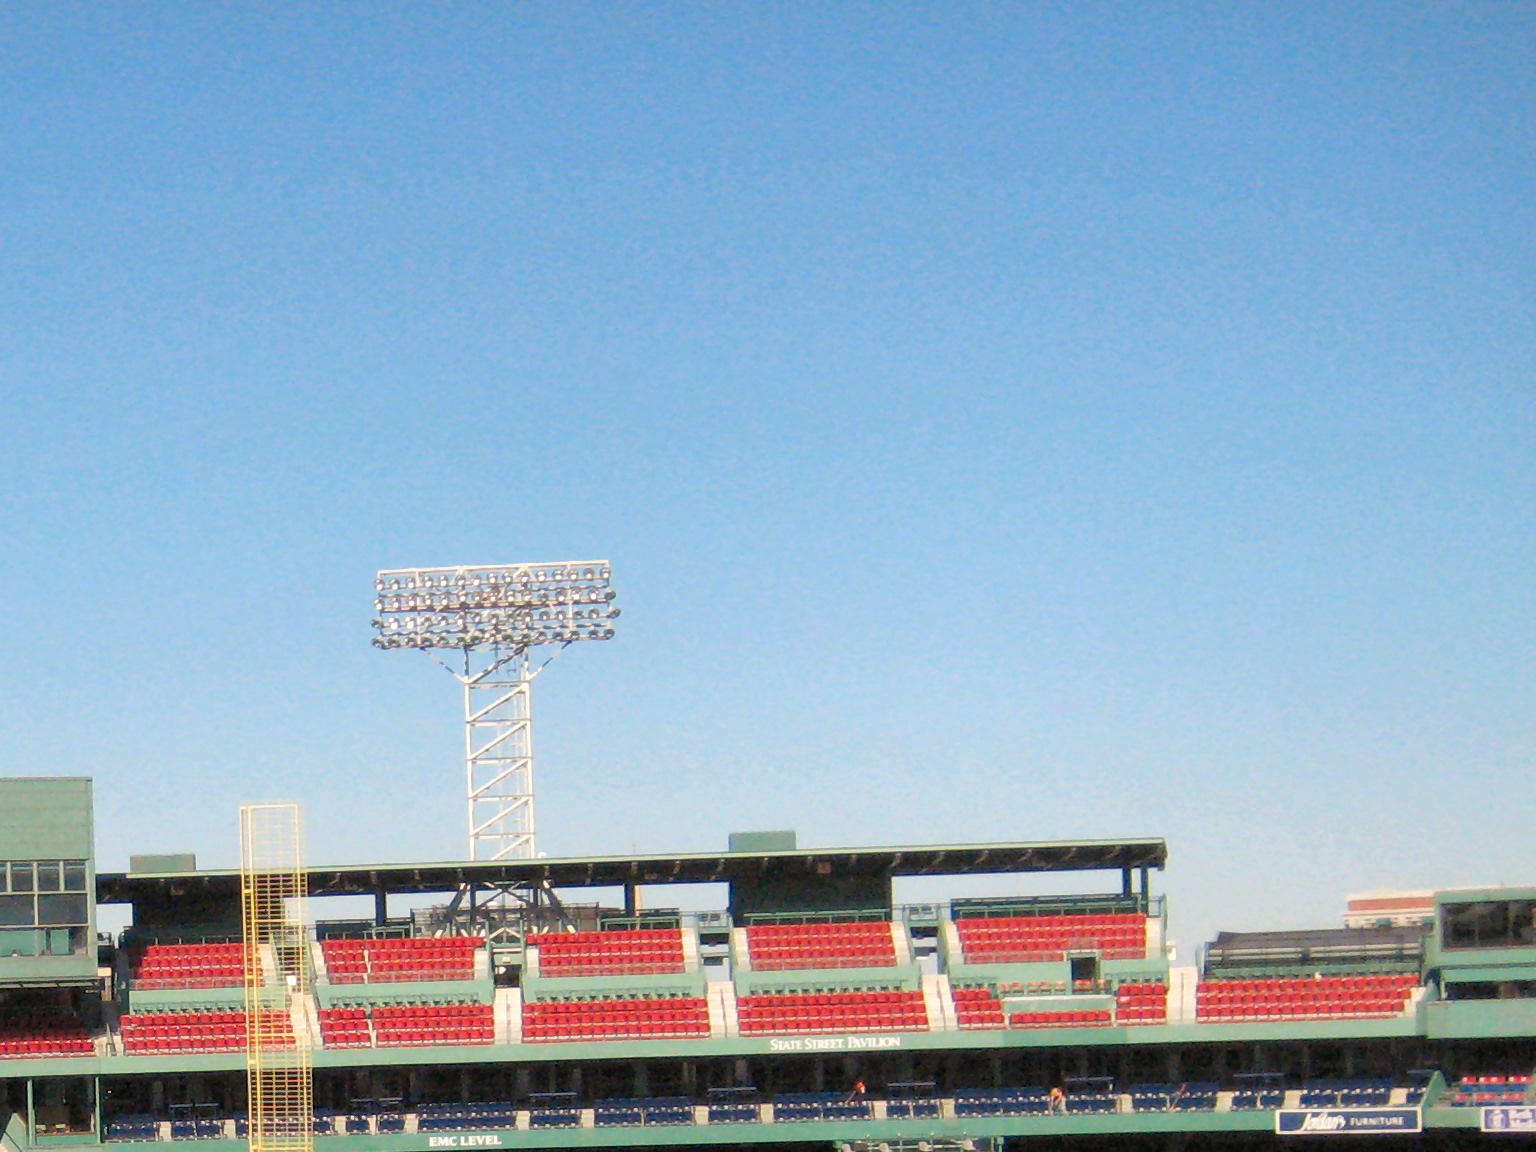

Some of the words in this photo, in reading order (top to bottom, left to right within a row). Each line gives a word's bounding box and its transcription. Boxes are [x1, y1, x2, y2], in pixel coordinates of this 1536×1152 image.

[770, 1039, 802, 1050] STATE
[804, 1038, 844, 1050] STREET
[847, 1036, 901, 1049] PAVILION
[1349, 1116, 1405, 1126] FURNITURE
[429, 1136, 457, 1147] EMC
[460, 1135, 502, 1146] LEVEL
